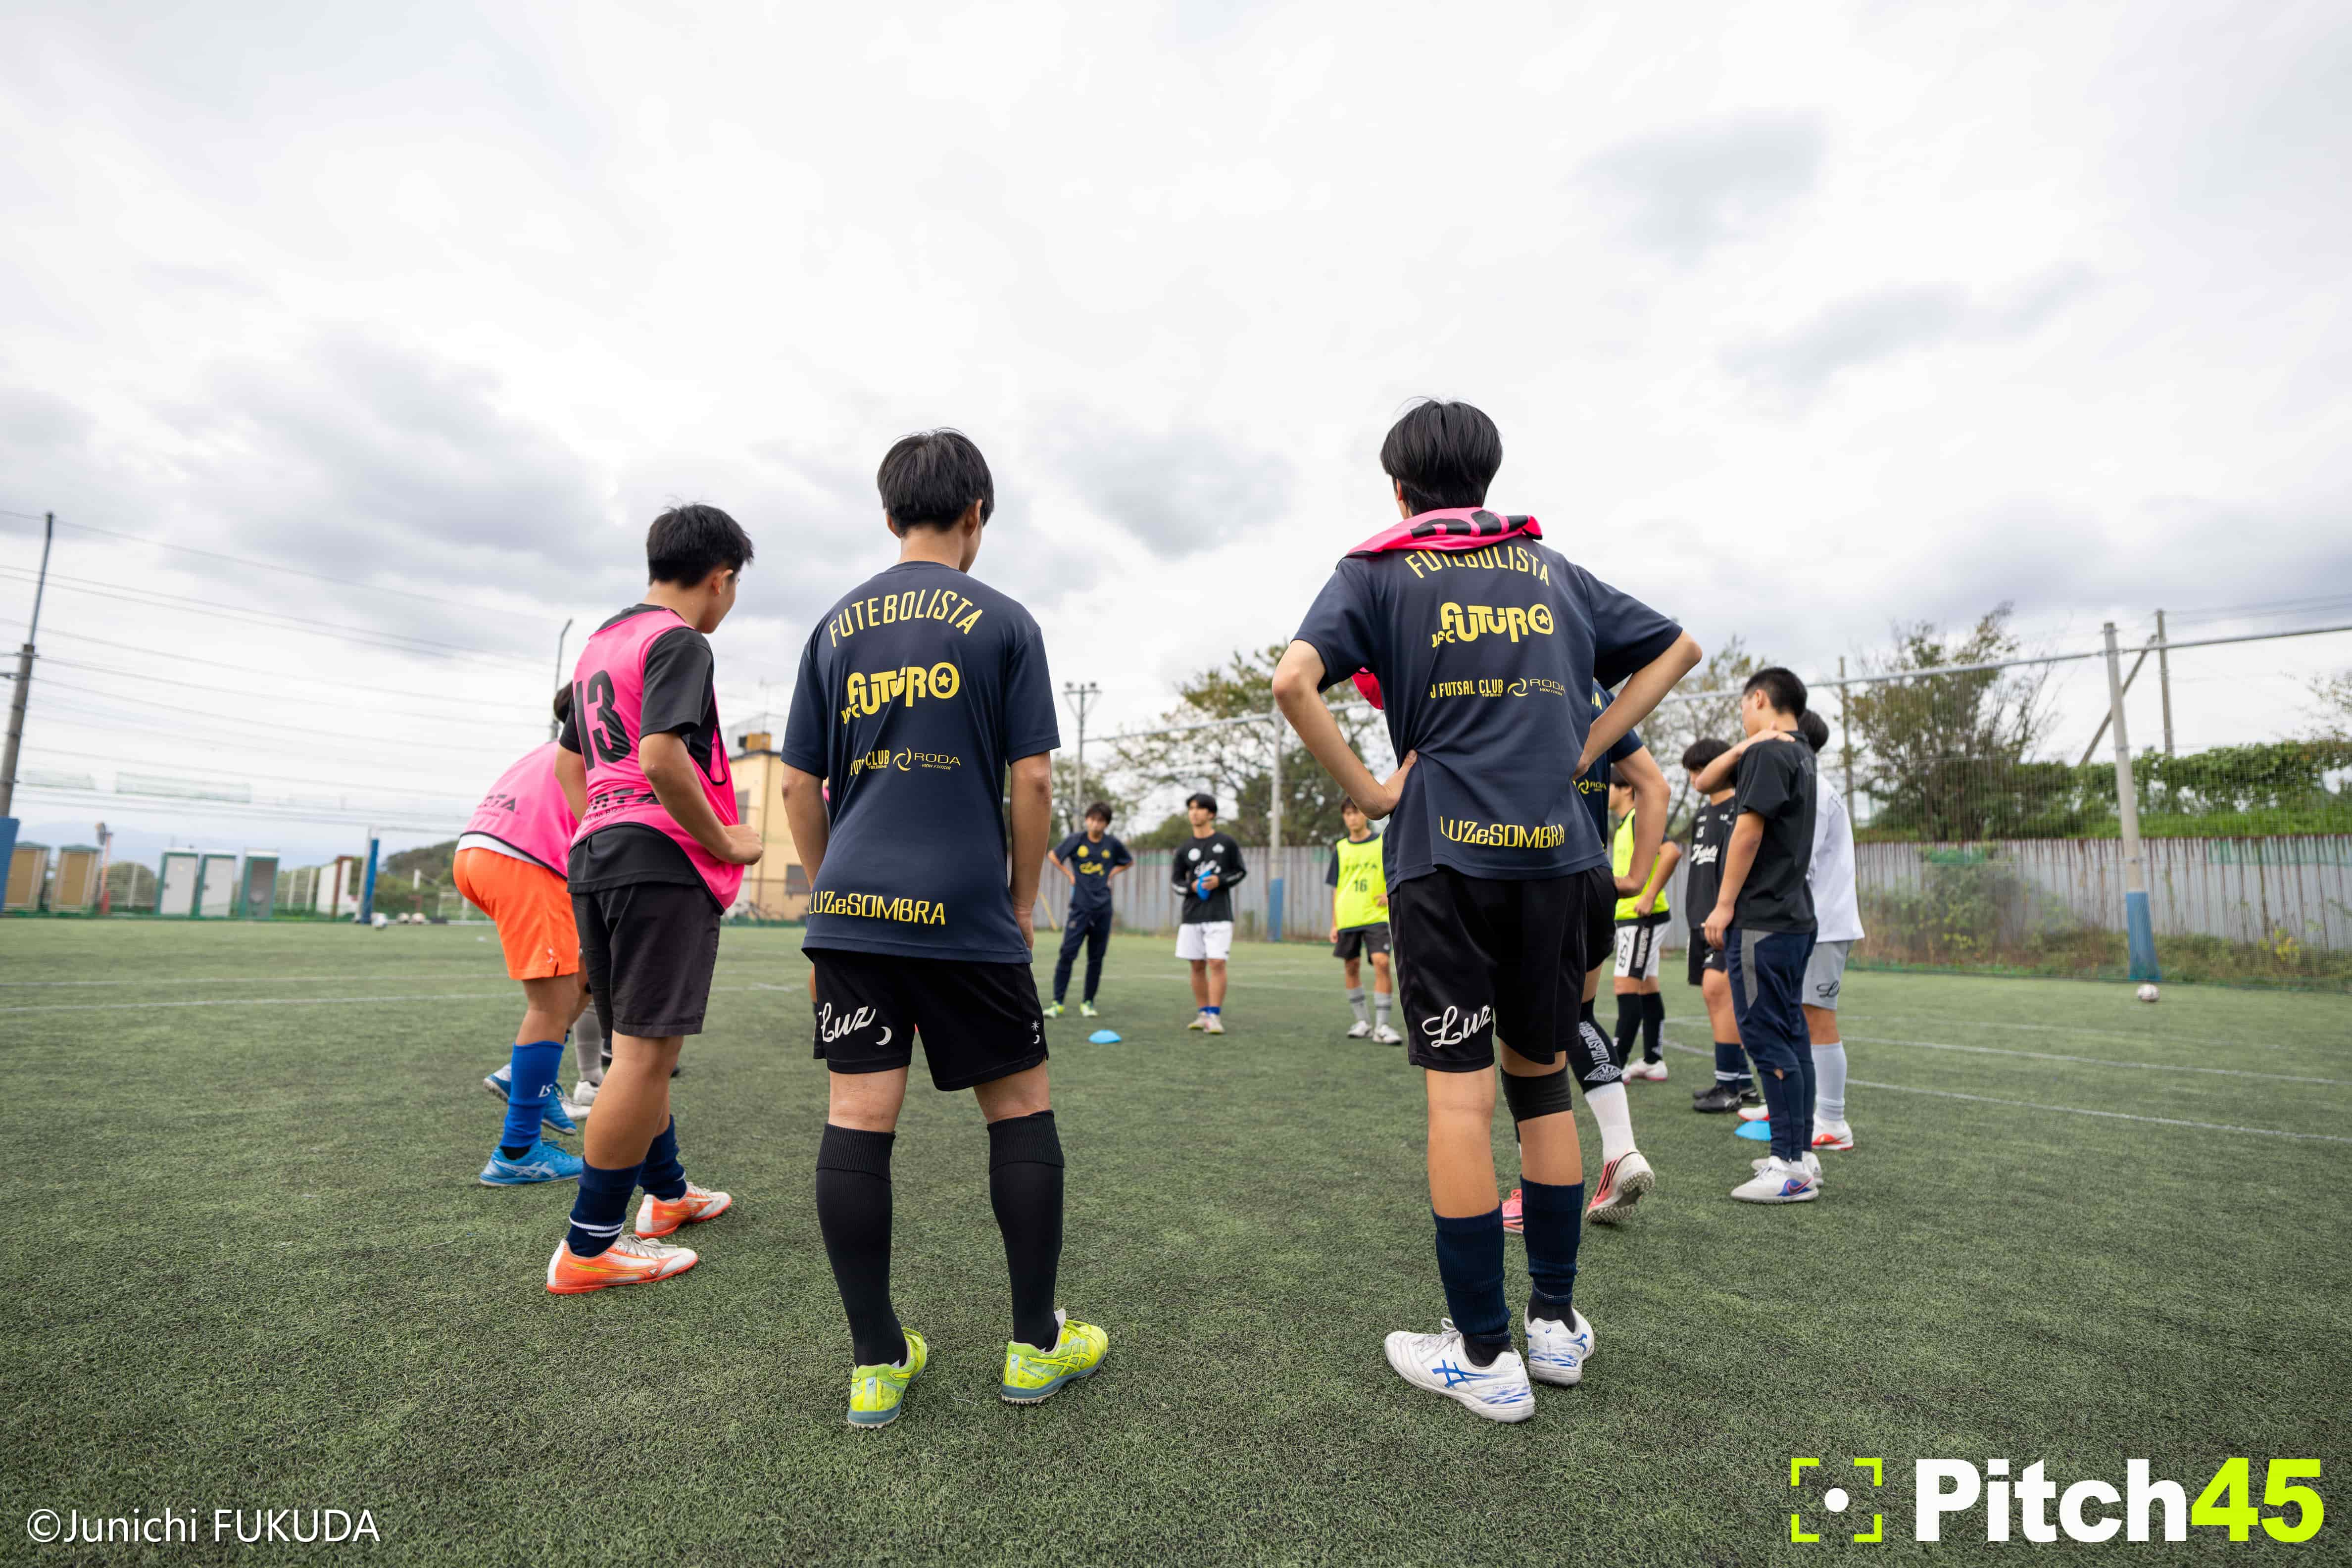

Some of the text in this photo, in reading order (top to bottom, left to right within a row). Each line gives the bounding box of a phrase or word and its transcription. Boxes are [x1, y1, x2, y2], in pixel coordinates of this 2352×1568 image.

[829, 589, 983, 647] FUTEBOLISTA
[1440, 602, 1554, 642] FUTURO
[847, 662, 960, 715] FUTURO
[1430, 679, 1503, 698] J FUTSAL CLUB
[1529, 679, 1566, 693] RODA
[575, 670, 632, 771] 13
[866, 749, 890, 766] CLUB
[914, 752, 961, 766] RODA
[1440, 815, 1565, 848] LUZeSOMBRA
[1354, 879, 1368, 892] 16
[808, 890, 946, 925] LUZeSOMBRA
[818, 1002, 877, 1042] Luz
[1421, 1005, 1491, 1048] Luz
